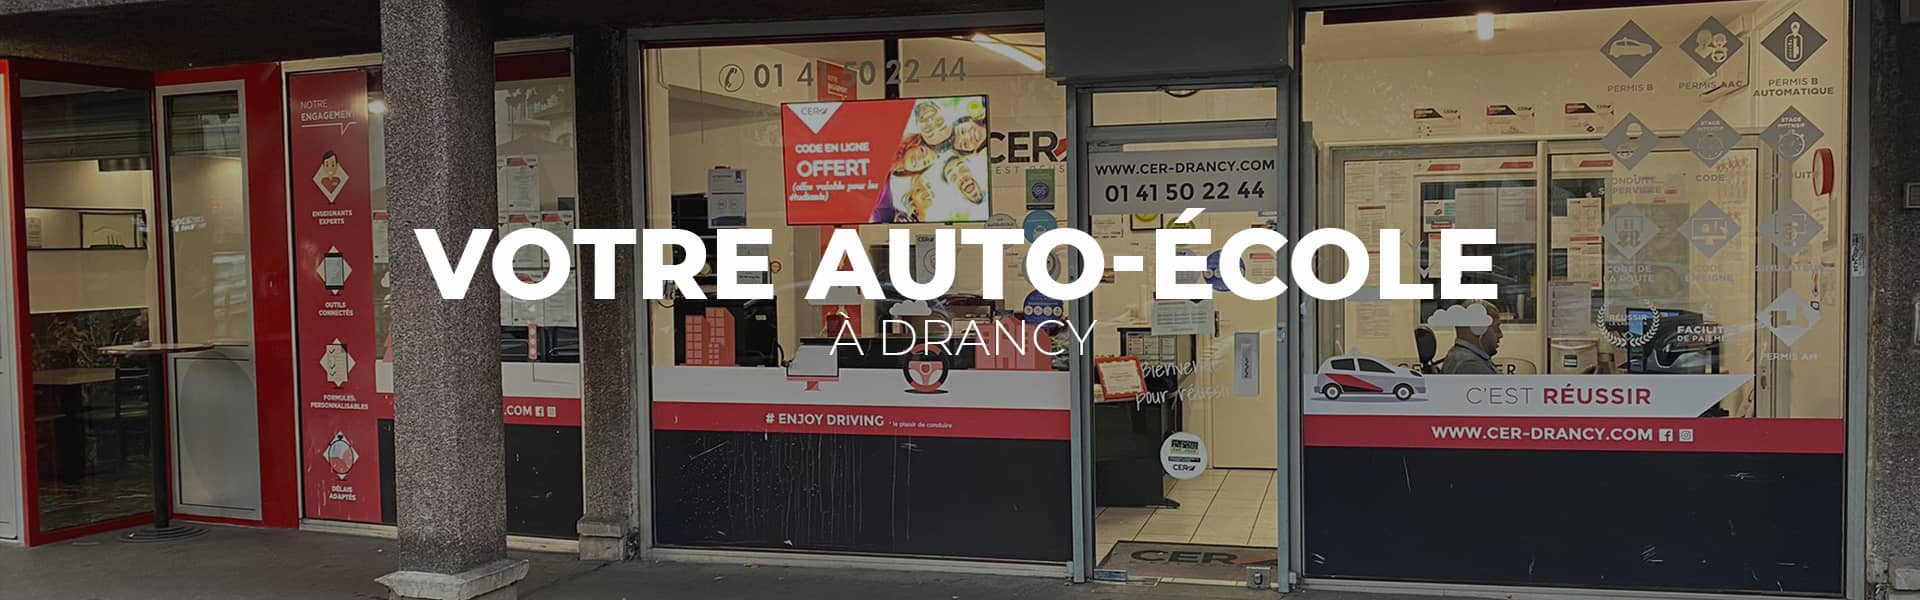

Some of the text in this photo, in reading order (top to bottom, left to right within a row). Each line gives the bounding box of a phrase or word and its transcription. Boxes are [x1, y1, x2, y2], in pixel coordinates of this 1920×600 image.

[754, 63, 783, 88] 01
[797, 62, 826, 87] 41
[843, 60, 876, 86] 50
[886, 58, 920, 85] 22
[931, 56, 967, 82] 44
[1607, 83, 1654, 93] PERMIS B
[1679, 80, 1743, 90] PERMIS AAC
[1769, 77, 1819, 87] PERMIS B
[1753, 87, 1834, 97] AUTOMATIQUE
[301, 99, 328, 109] NOTRE
[795, 141, 871, 154] CODE EN LIGNE
[990, 131, 1058, 163] CER
[796, 158, 871, 178] OFFERT
[1095, 160, 1275, 176] WWW.CER-DRANCY.COM
[1696, 174, 1725, 183] CODE
[1105, 181, 1265, 202] 01 41 50 22 44
[1677, 326, 1732, 335] FACILIT
[1136, 389, 1168, 411] pour
[1466, 384, 1652, 405] C'EST RÉUSSIR
[766, 413, 885, 427] # ENJOY DRIVING
[1431, 426, 1653, 442] WWW.CER-DRANCY.COM
[1131, 550, 1239, 565] CER
